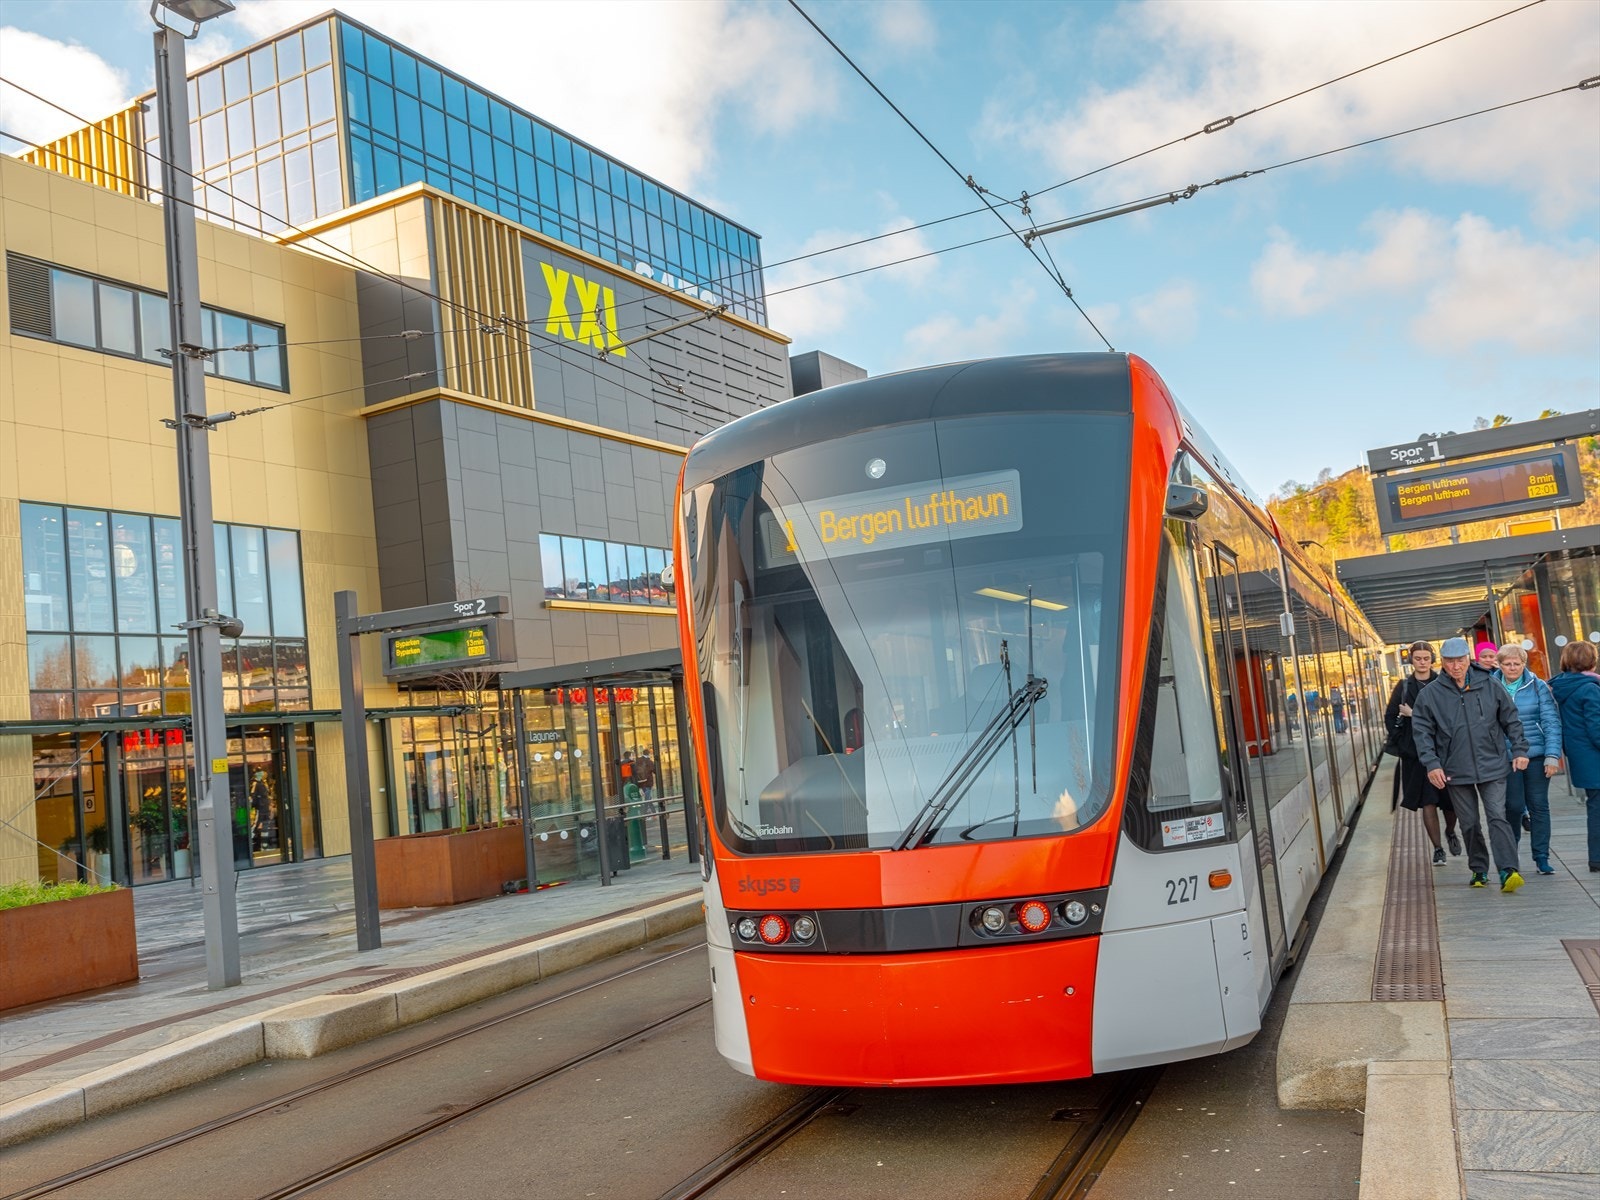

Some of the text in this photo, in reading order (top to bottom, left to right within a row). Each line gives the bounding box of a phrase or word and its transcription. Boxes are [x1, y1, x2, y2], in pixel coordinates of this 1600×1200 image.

[539, 261, 627, 358] XXL
[1390, 441, 1445, 461] Spor 1
[1405, 457, 1425, 466] Track
[1398, 483, 1431, 496] Bergen
[1432, 476, 1469, 489] lufthavn
[1400, 493, 1433, 506] Bergen
[1434, 487, 1470, 500] lufthavn
[783, 519, 798, 552] 1
[819, 510, 903, 545] Bergen
[453, 599, 487, 614] Spor 2
[395, 639, 420, 649] Byparken
[396, 648, 421, 657] Byparken
[529, 731, 559, 744] Lagunen
[738, 874, 787, 897] skyss
[1165, 875, 1198, 906] 227
[1241, 923, 1248, 941] B
